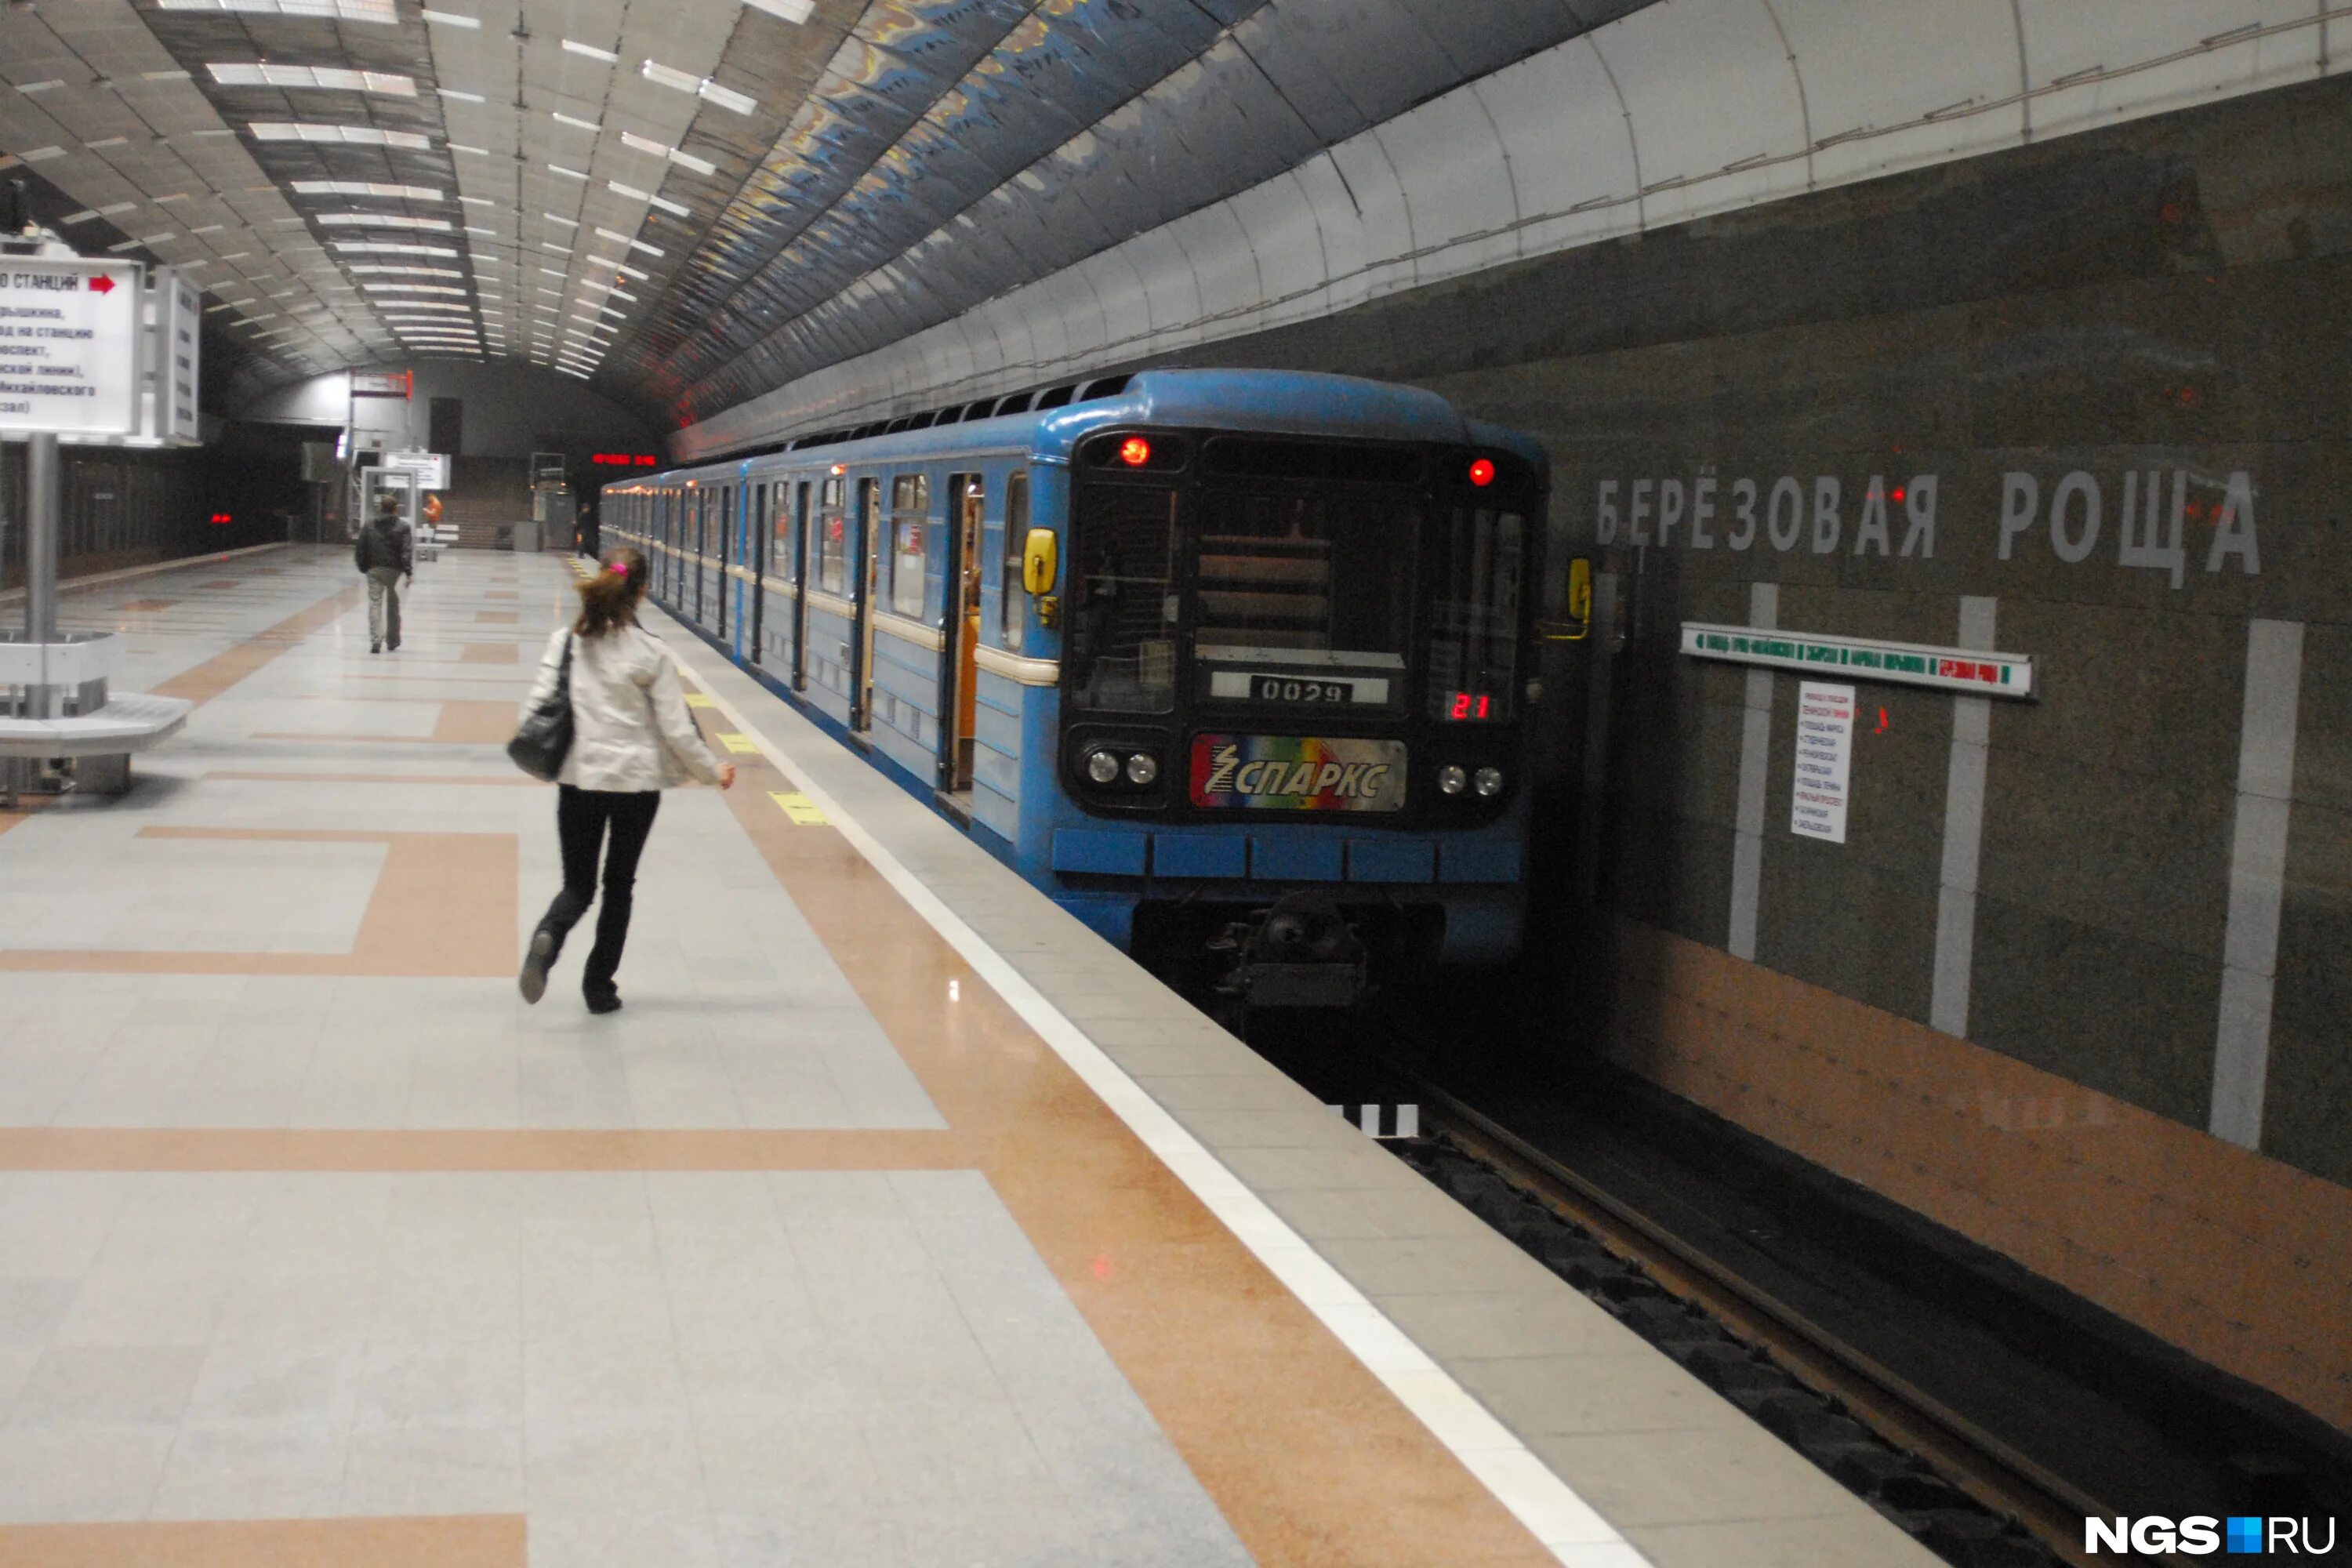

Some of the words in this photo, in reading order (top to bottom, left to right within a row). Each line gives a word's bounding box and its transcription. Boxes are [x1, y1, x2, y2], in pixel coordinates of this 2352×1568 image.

[13, 272, 78, 292] СТАНЦИЙ
[1595, 466, 1938, 558] БЕРЁЗОВАЯ
[1998, 470, 2261, 590] РОЩА
[1261, 680, 1342, 703] 0029
[1451, 691, 1490, 720] 21
[1234, 760, 1390, 798] СПАРКС
